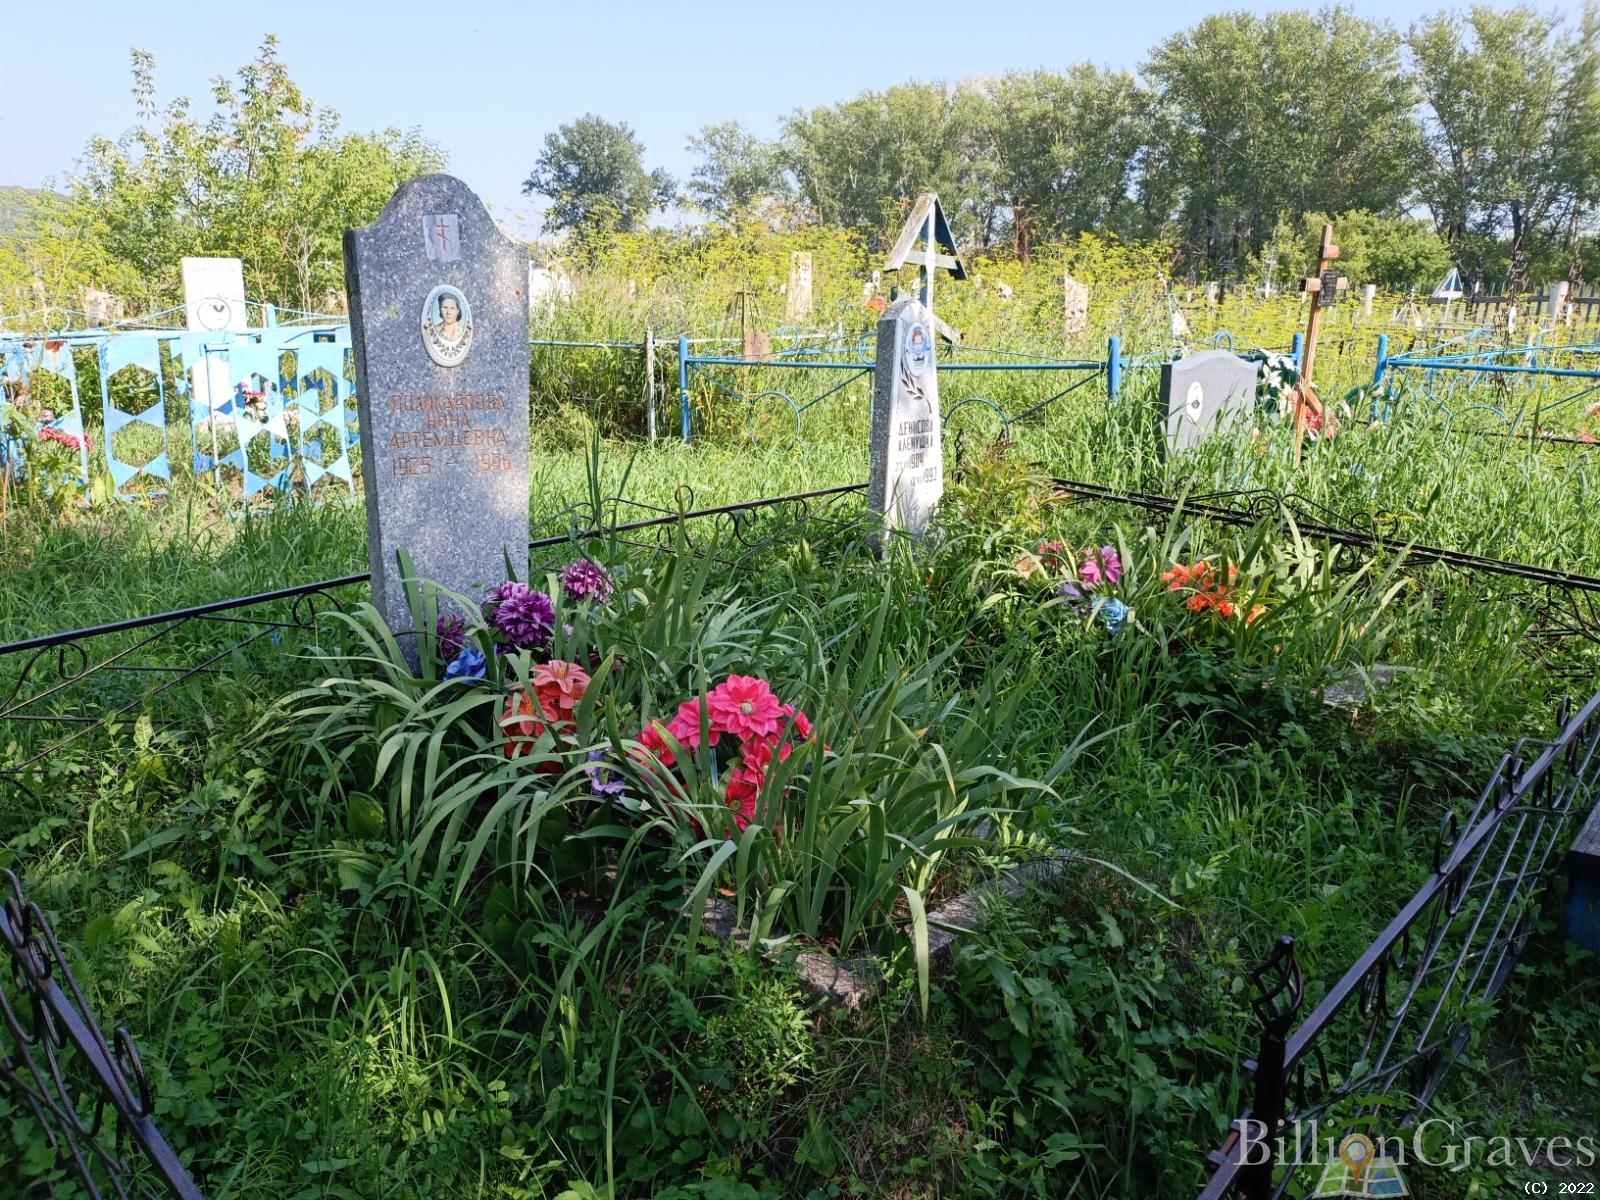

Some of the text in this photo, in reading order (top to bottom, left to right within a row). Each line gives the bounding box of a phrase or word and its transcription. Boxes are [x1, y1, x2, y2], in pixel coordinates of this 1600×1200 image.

[427, 410, 472, 431] НИНА
[898, 419, 933, 436] ДЕНИСОВА
[391, 454, 433, 478] 1925
